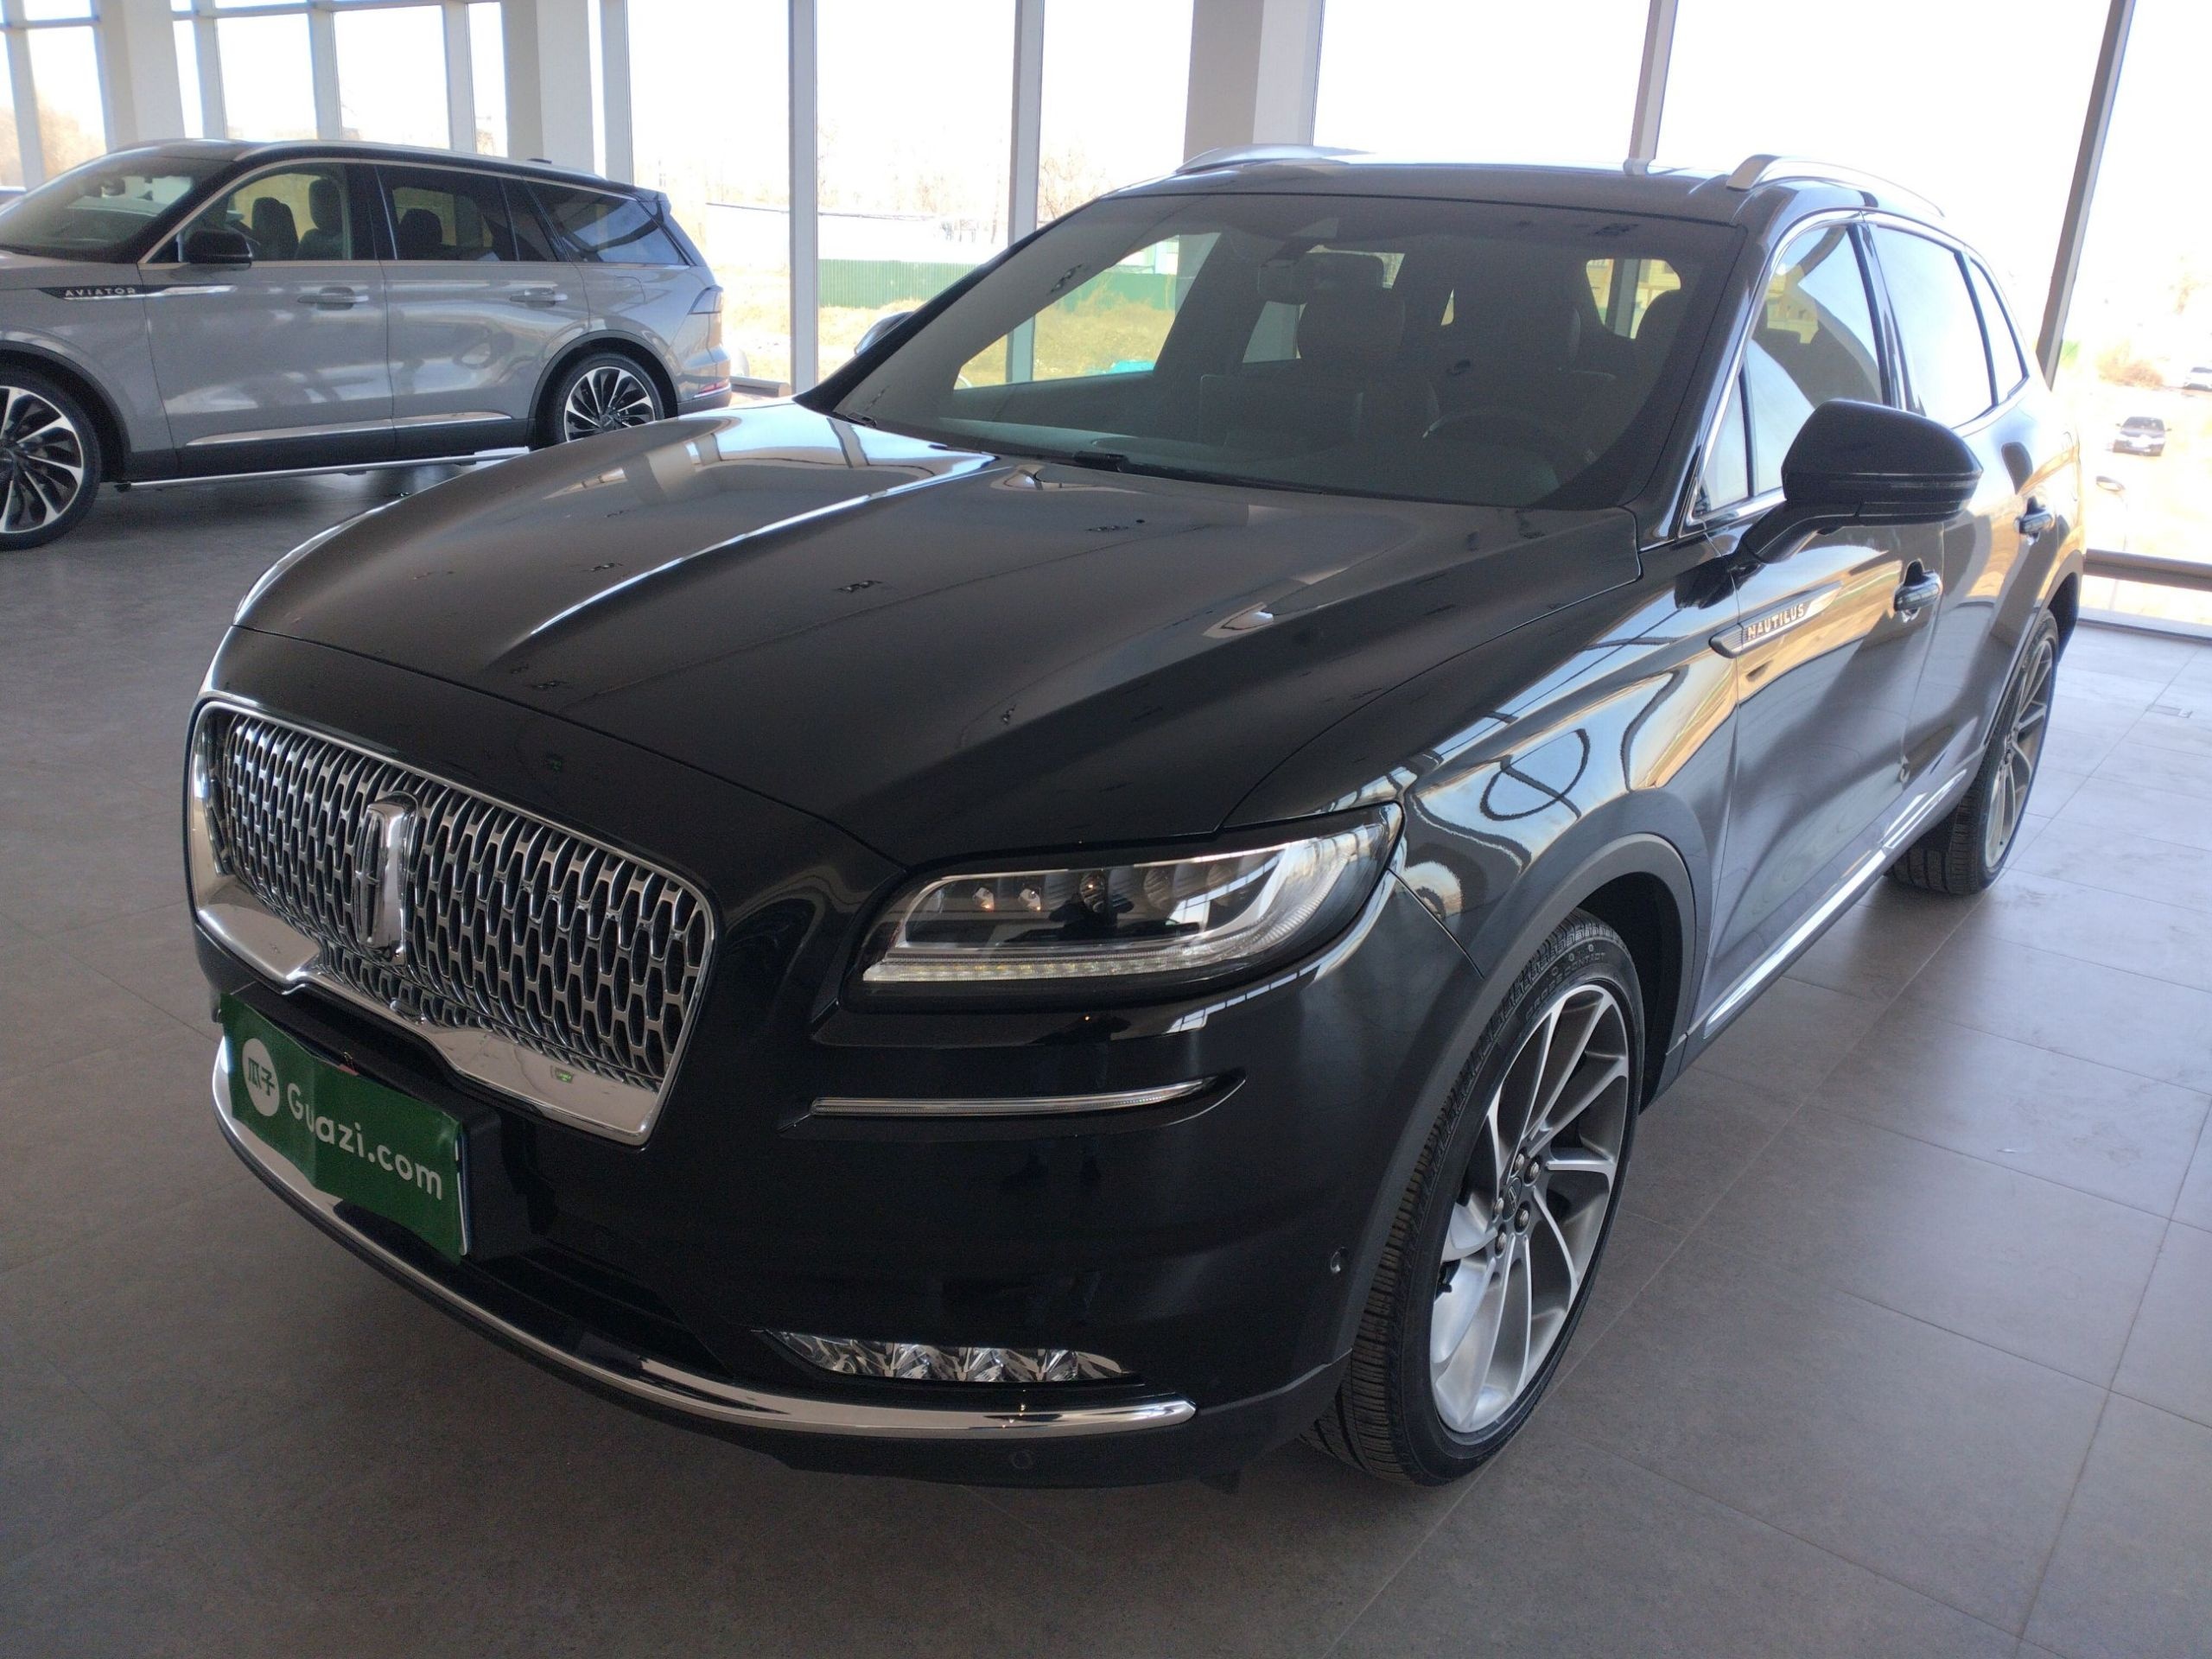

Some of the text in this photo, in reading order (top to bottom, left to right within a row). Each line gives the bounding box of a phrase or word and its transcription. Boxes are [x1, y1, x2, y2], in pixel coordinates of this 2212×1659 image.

[65, 287, 137, 297] AVIATOR
[1747, 603, 1804, 639] NAUTILUS
[287, 1083, 442, 1200] Guazi.com
